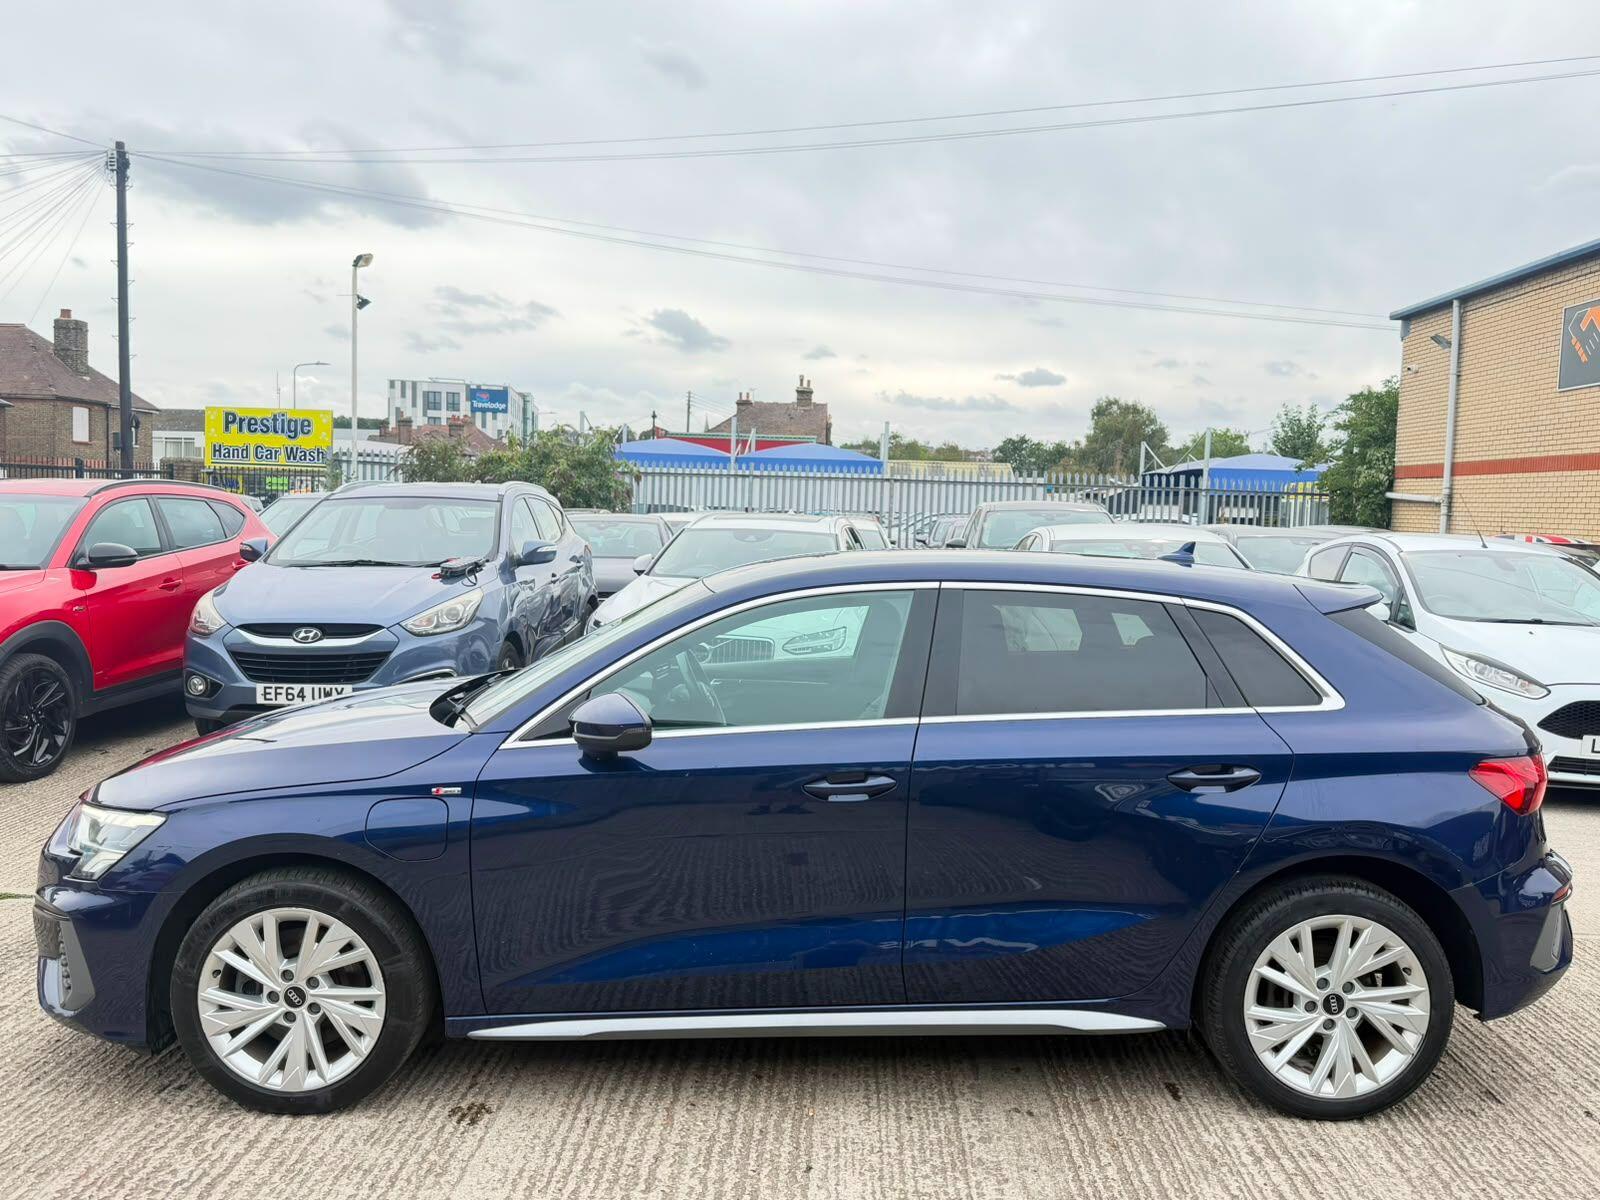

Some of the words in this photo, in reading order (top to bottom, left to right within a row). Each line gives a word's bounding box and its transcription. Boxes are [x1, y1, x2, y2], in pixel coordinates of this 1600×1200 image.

[472, 400, 506, 411] Travelodge
[224, 410, 313, 439] Prestige
[212, 443, 249, 460] Hand
[254, 444, 280, 461] Car
[284, 446, 324, 462] Wash
[263, 686, 306, 701] EF64
